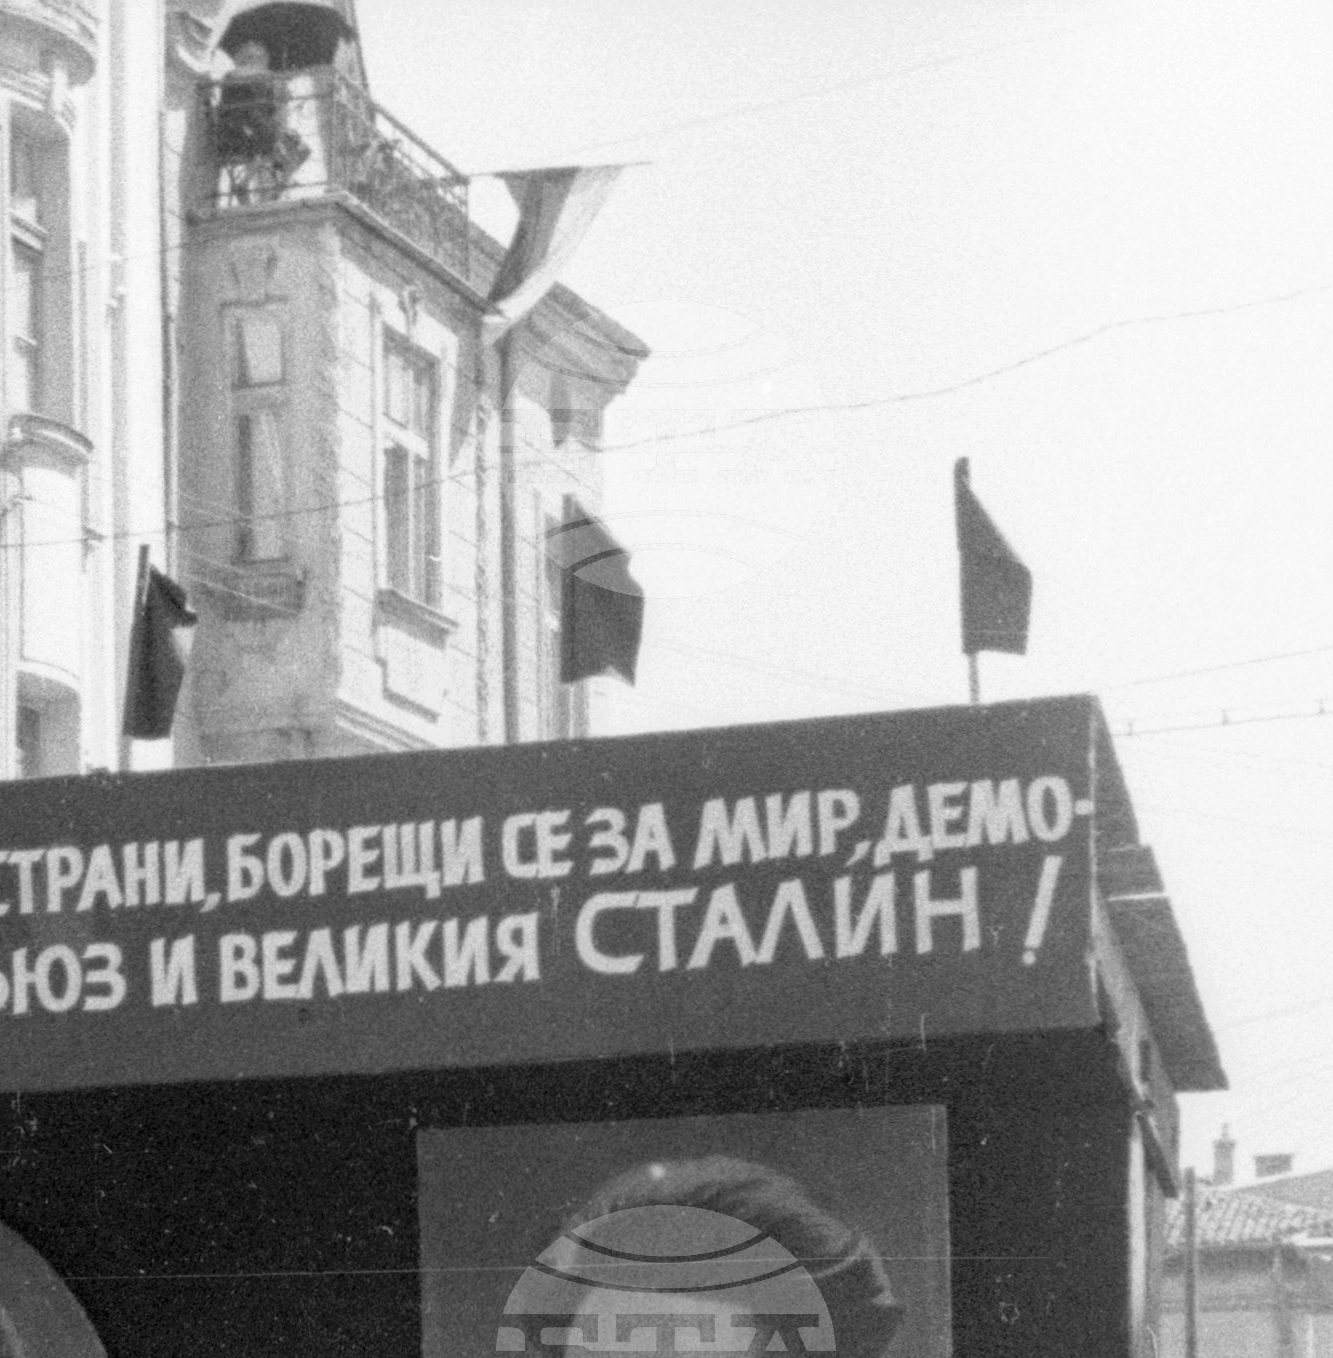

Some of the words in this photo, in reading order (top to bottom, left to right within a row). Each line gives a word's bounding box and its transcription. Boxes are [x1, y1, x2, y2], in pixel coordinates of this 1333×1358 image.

[227, 815, 485, 902] БОРЕЩИ
[501, 810, 574, 880] СЕ
[585, 803, 676, 876] ЗА
[873, 774, 1094, 863] ДЕМО-
[150, 934, 198, 1006] И
[219, 911, 540, 1002] ВЕЛИКИЯ
[574, 863, 981, 974] СТАЛИН
